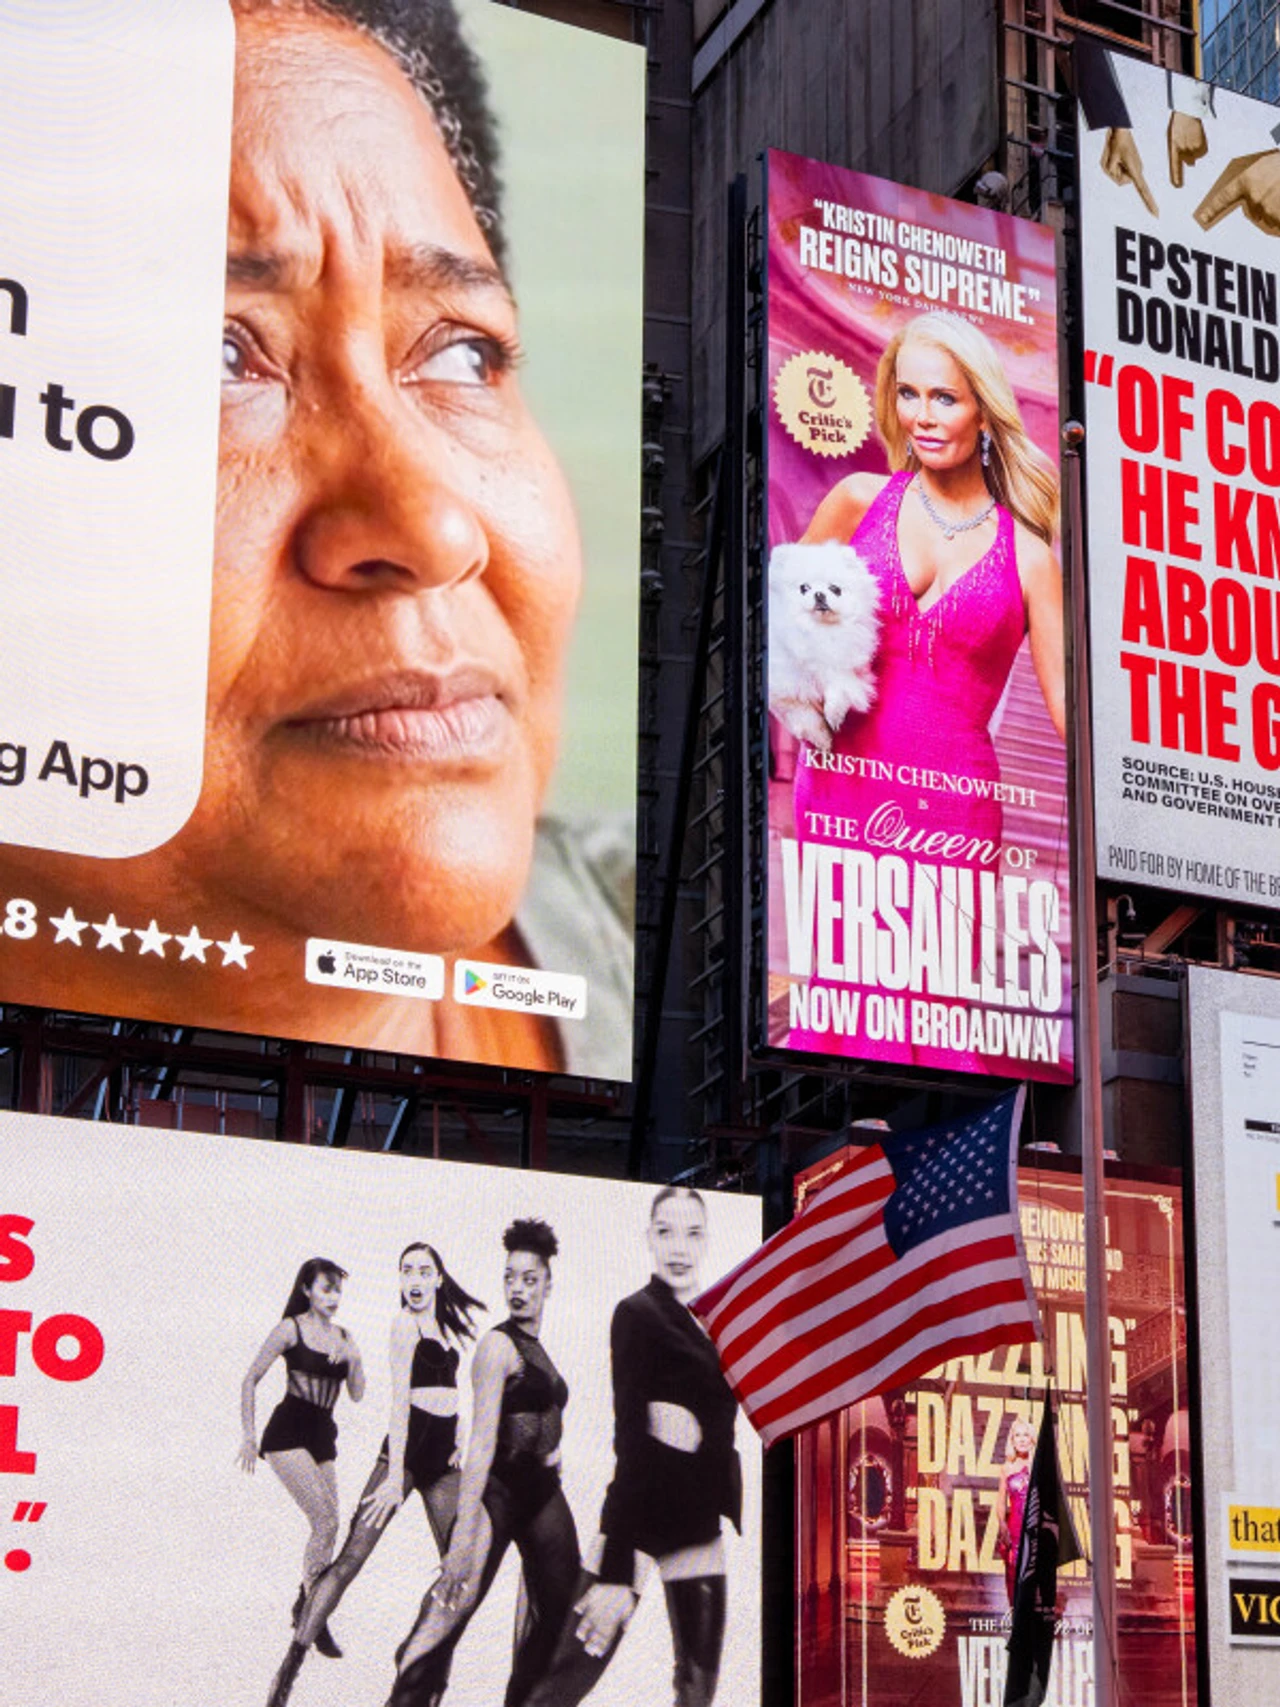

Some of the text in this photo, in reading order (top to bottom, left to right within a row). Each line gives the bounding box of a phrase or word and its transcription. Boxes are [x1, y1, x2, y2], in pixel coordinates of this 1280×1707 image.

[813, 198, 1007, 276] “KRISTIN CHENOWETH
[800, 226, 1040, 326] REIGNS SUPREME.”
[848, 283, 874, 295] NEW
[879, 290, 910, 307] YORK
[1115, 225, 1278, 326] EPSTEIN
[1117, 287, 1279, 384] DONALD
[39, 382, 135, 461] to
[798, 411, 852, 429] Critic's
[809, 427, 847, 443] Pick
[1083, 349, 1194, 462] “OF
[1121, 457, 1203, 562] HE
[1119, 650, 1241, 763] THE
[38, 740, 149, 804] App
[804, 749, 1036, 807] KRISTIN CHENOWETH
[1122, 756, 1195, 782] SOURCE:
[1198, 772, 1228, 789] U.S.
[1122, 772, 1221, 802] COMMITTEE
[1224, 791, 1248, 808] ON
[805, 801, 1038, 870] THE Queen OF
[1122, 787, 1158, 804] AND
[1161, 795, 1274, 828] GOVERNMENT
[1108, 845, 1137, 872] PAID
[1139, 851, 1165, 877] FOR
[1167, 855, 1183, 880] BY
[1186, 859, 1223, 887] HOME
[1225, 866, 1241, 889] OF
[1243, 869, 1266, 896] THE
[781, 838, 1062, 1013] VERSAILLES
[343, 963, 427, 989] App Store
[346, 951, 422, 970] Download on the
[492, 983, 577, 1012] Google Play
[789, 983, 1064, 1065] NOW ON BROADWAY
[968, 1617, 998, 1632] THE
